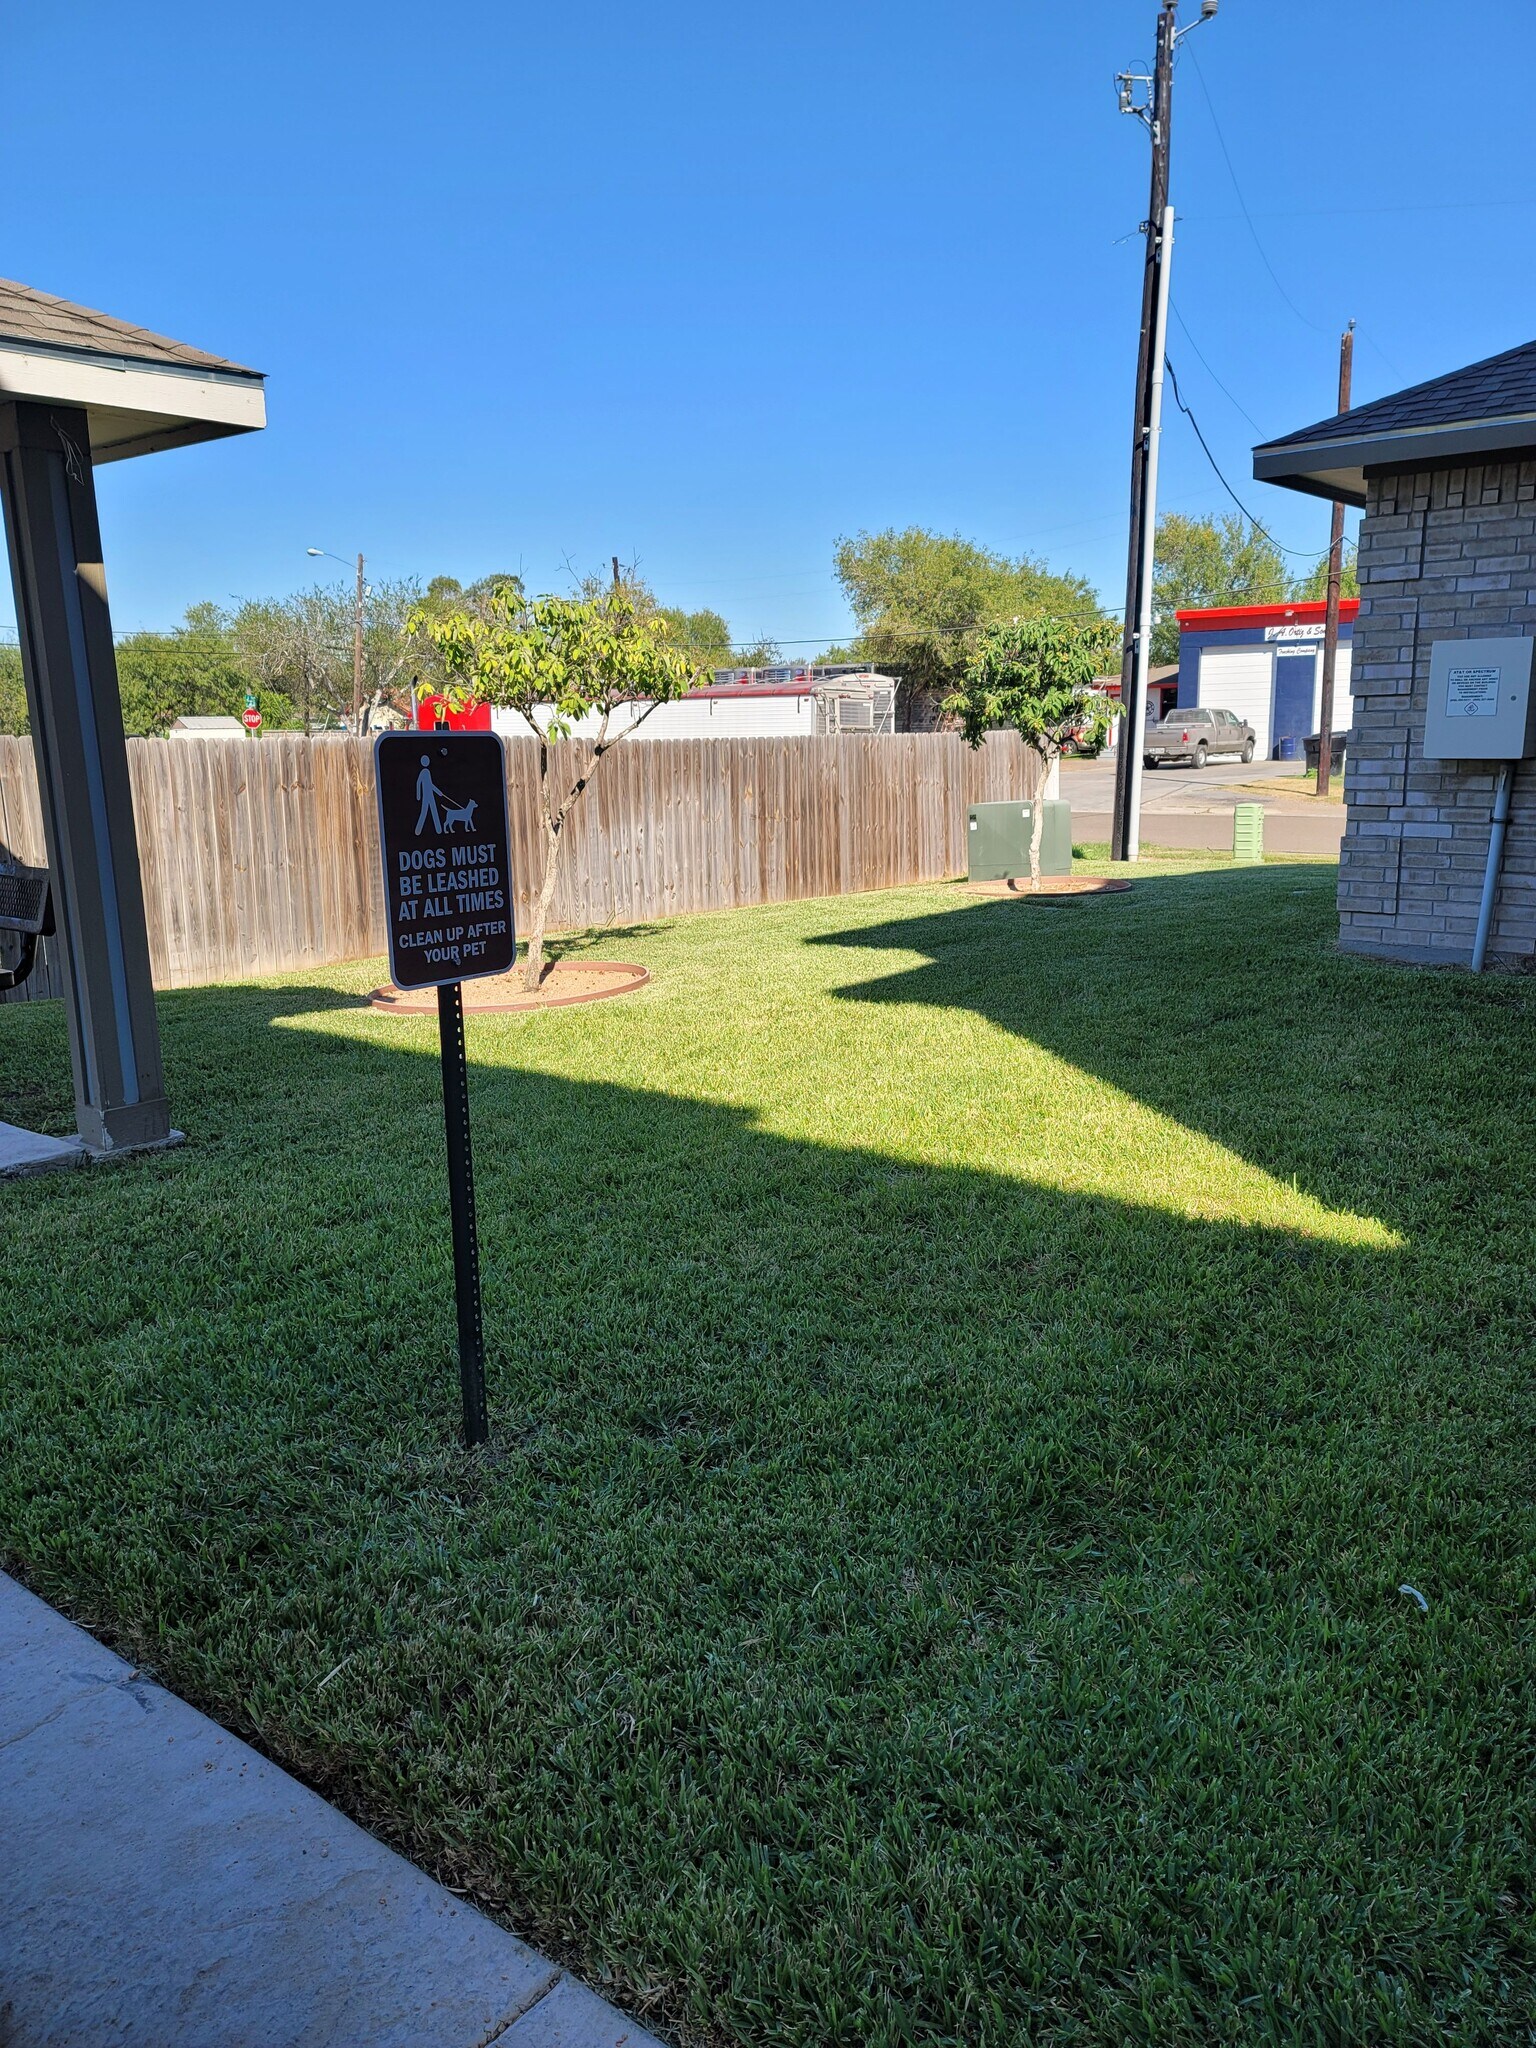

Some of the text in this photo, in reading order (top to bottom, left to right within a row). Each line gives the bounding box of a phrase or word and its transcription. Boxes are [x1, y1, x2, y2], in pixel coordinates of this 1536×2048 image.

[1288, 626, 1304, 638] Ortiz
[1306, 626, 1312, 635] &
[244, 714, 260, 723] STOP
[399, 844, 497, 871] DOGS MUST
[399, 868, 499, 896] BE LEASHED
[398, 889, 504, 921] AT ALL TIMES
[399, 920, 506, 949] CLEAN UP AFTER
[424, 941, 486, 963] YOUR PET
